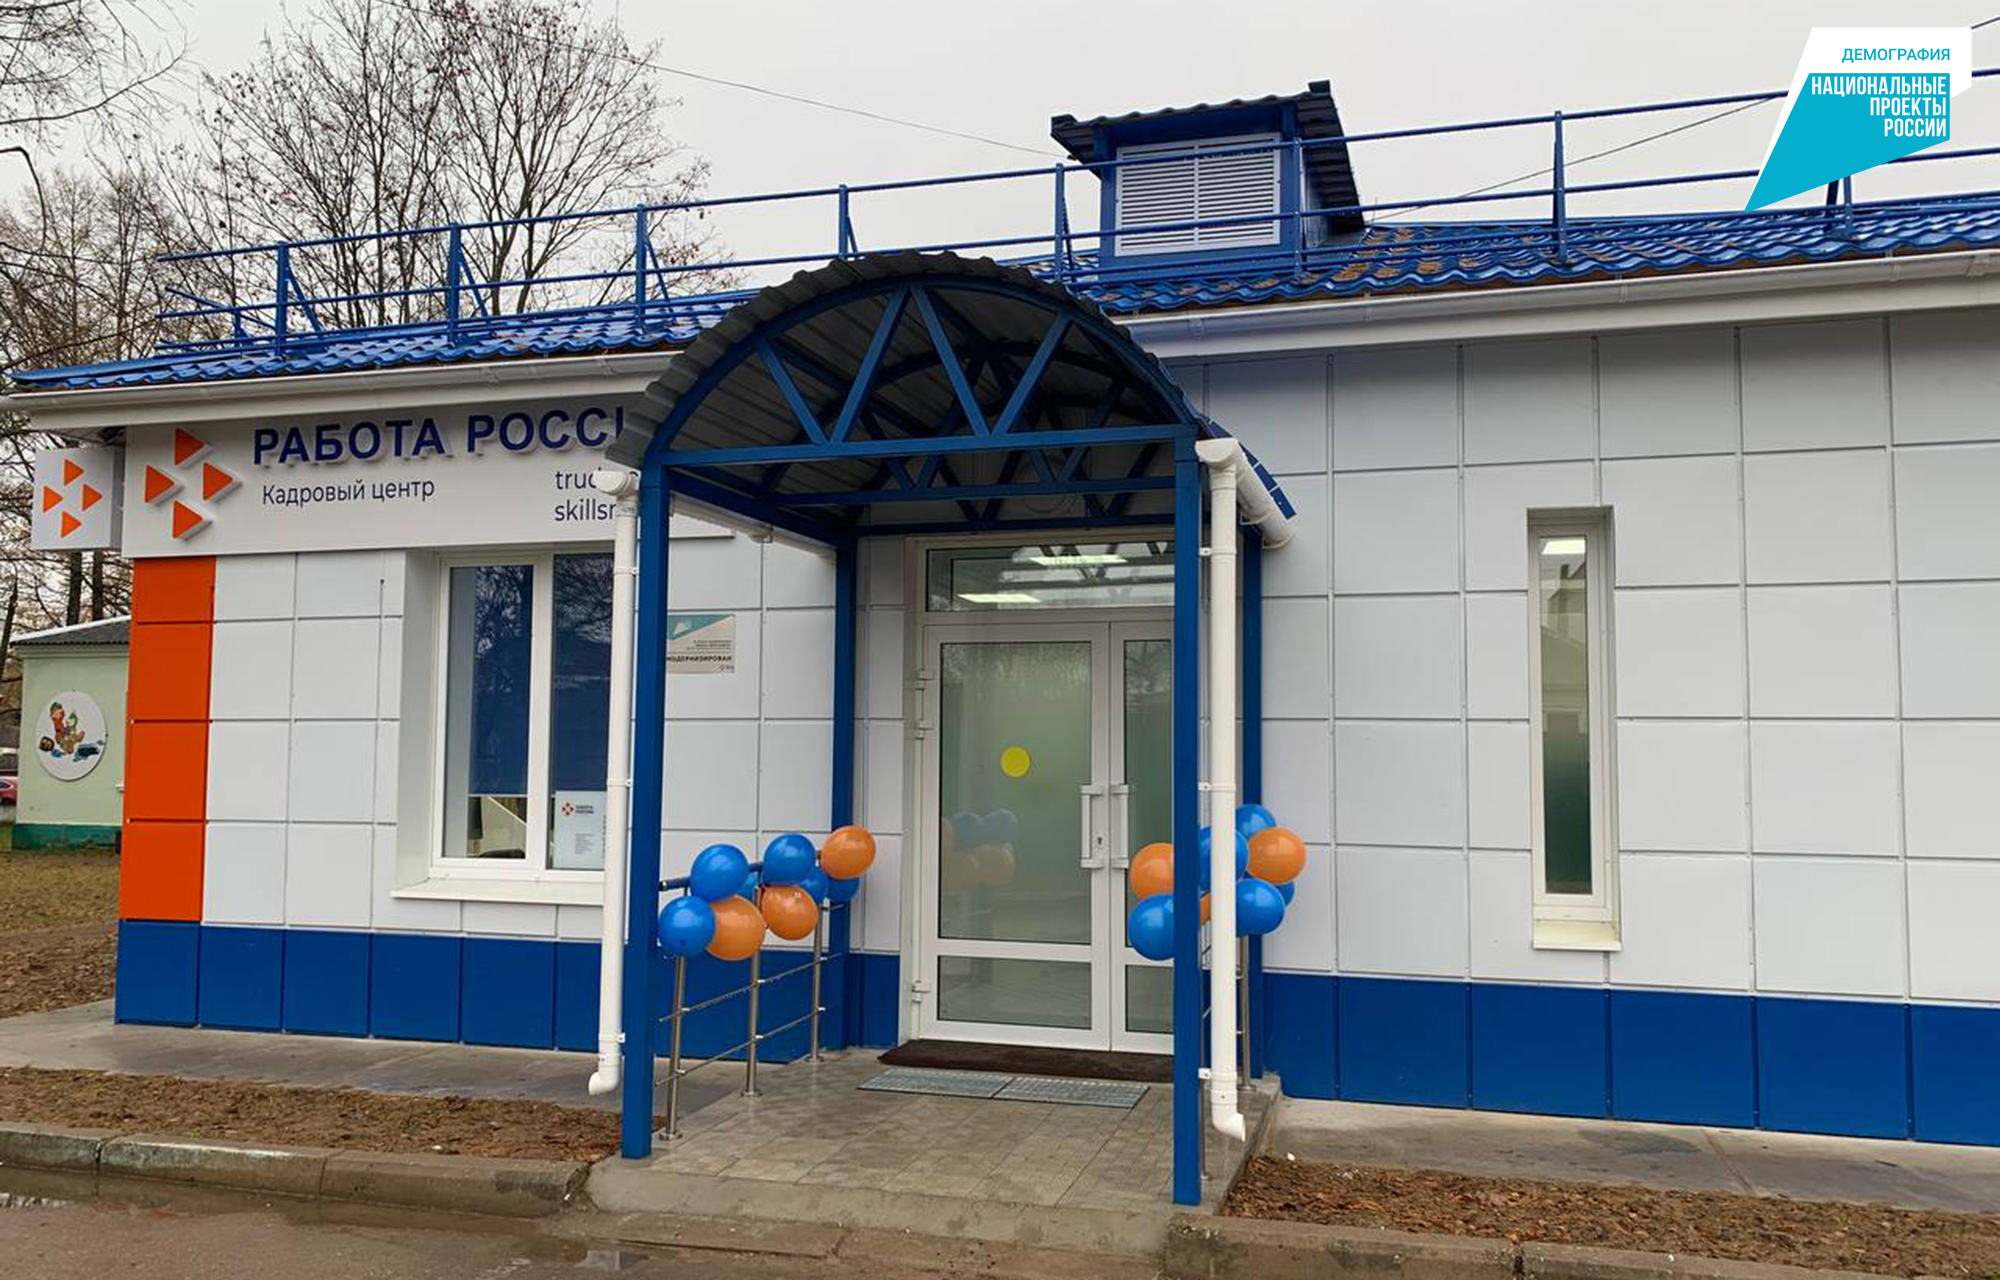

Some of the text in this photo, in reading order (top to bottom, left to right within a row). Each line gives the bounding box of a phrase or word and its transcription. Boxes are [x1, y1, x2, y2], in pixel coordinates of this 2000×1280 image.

[254, 418, 445, 465] РАБОТА
[263, 479, 435, 507] Кадровый центр
